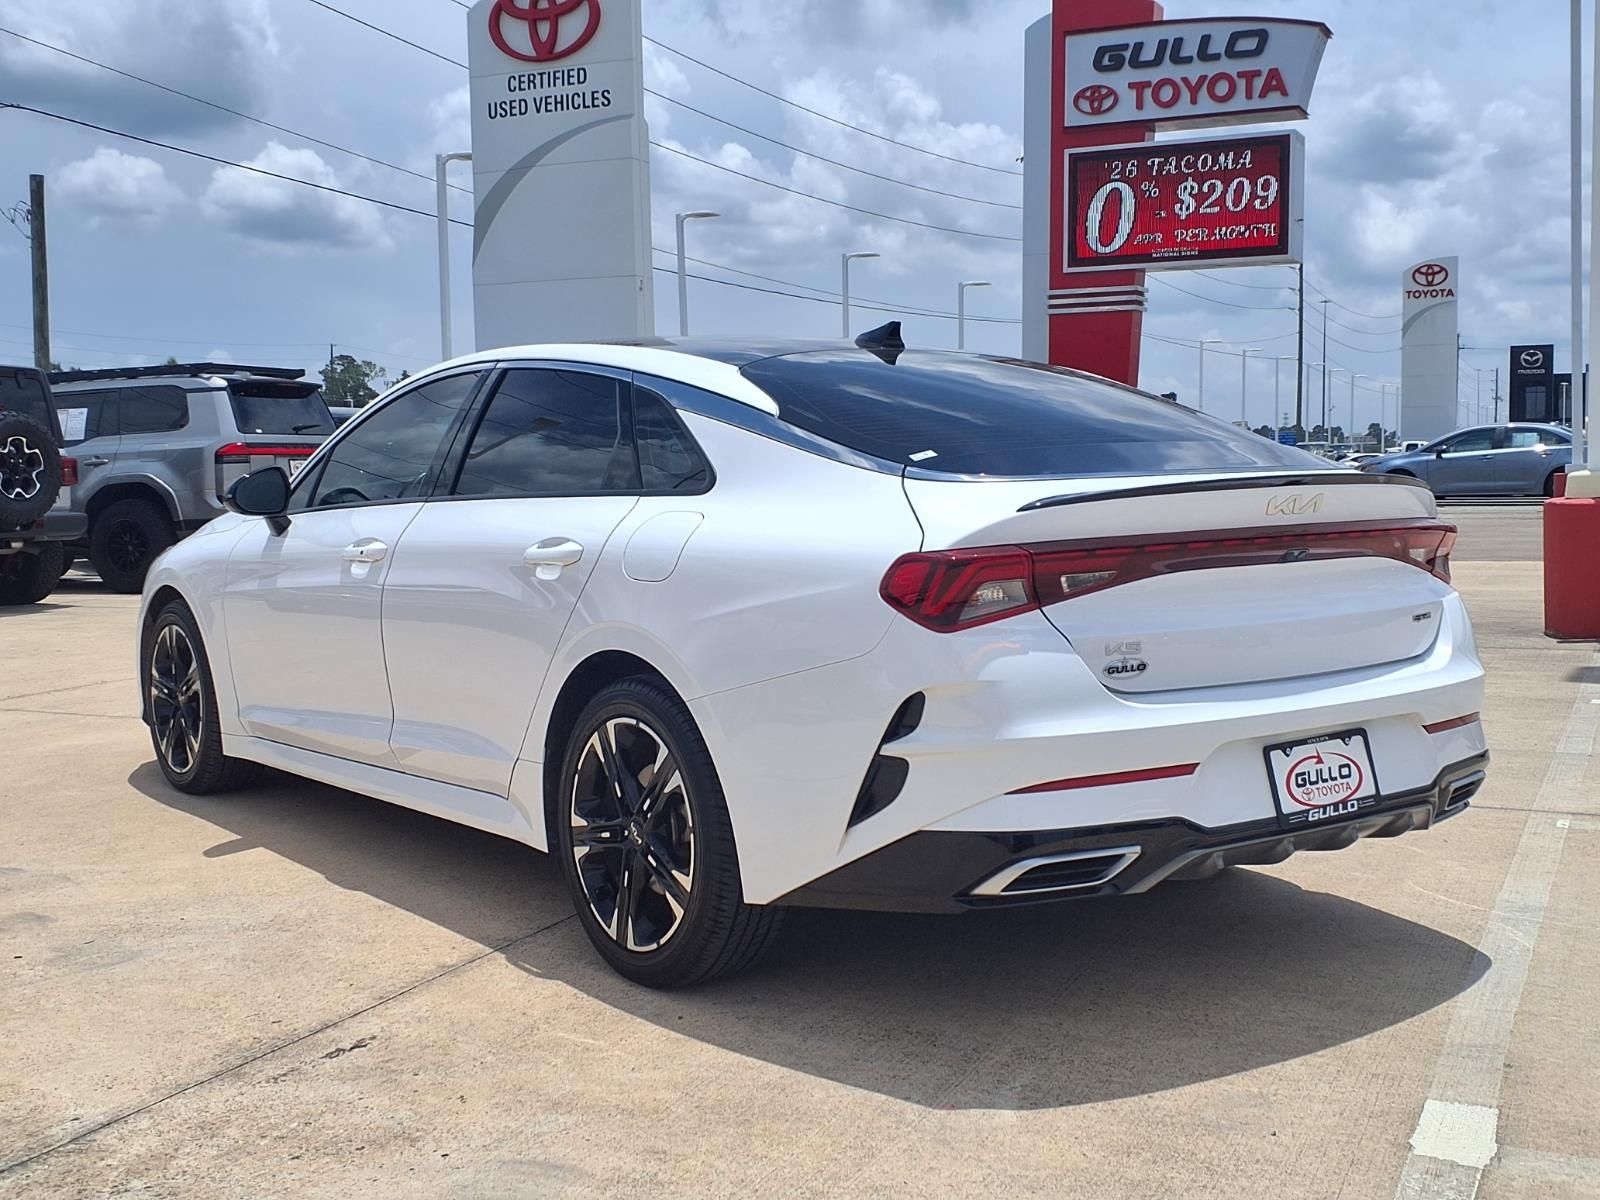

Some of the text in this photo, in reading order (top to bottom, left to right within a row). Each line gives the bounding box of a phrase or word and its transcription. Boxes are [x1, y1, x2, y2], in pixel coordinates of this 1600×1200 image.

[1092, 28, 1269, 73] GULLO
[507, 67, 588, 93] CERTIFIED
[1127, 67, 1289, 111] TOYOTA
[488, 89, 612, 120] USED VEHICLES
[1147, 149, 1253, 176] TACOMA
[1174, 174, 1279, 220] $209
[1133, 232, 1164, 245] APR
[1174, 227, 1209, 242] PER
[1405, 288, 1455, 299] TOYOTA
[1107, 663, 1147, 675] GULLO
[1295, 762, 1352, 788] GULLO
[1316, 781, 1353, 798] TOYOTA
[1308, 799, 1358, 822] GULLO
